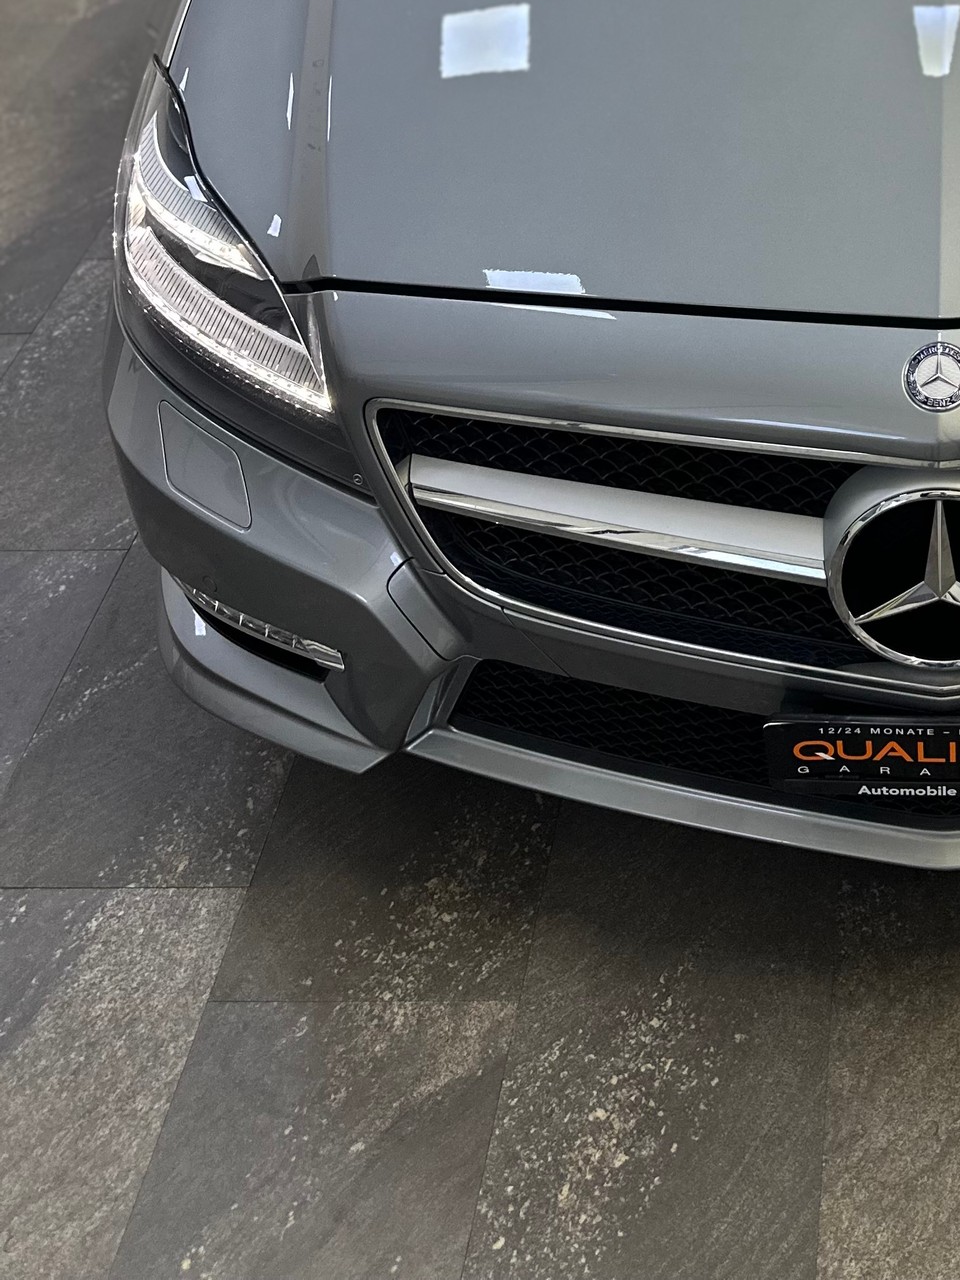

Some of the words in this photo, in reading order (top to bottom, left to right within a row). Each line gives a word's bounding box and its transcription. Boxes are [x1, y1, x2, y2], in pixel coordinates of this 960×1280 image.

[927, 399, 953, 407] BENZ
[818, 727, 862, 735] 12/24
[870, 728, 935, 736] MONATE
[858, 785, 957, 797] Automobile
